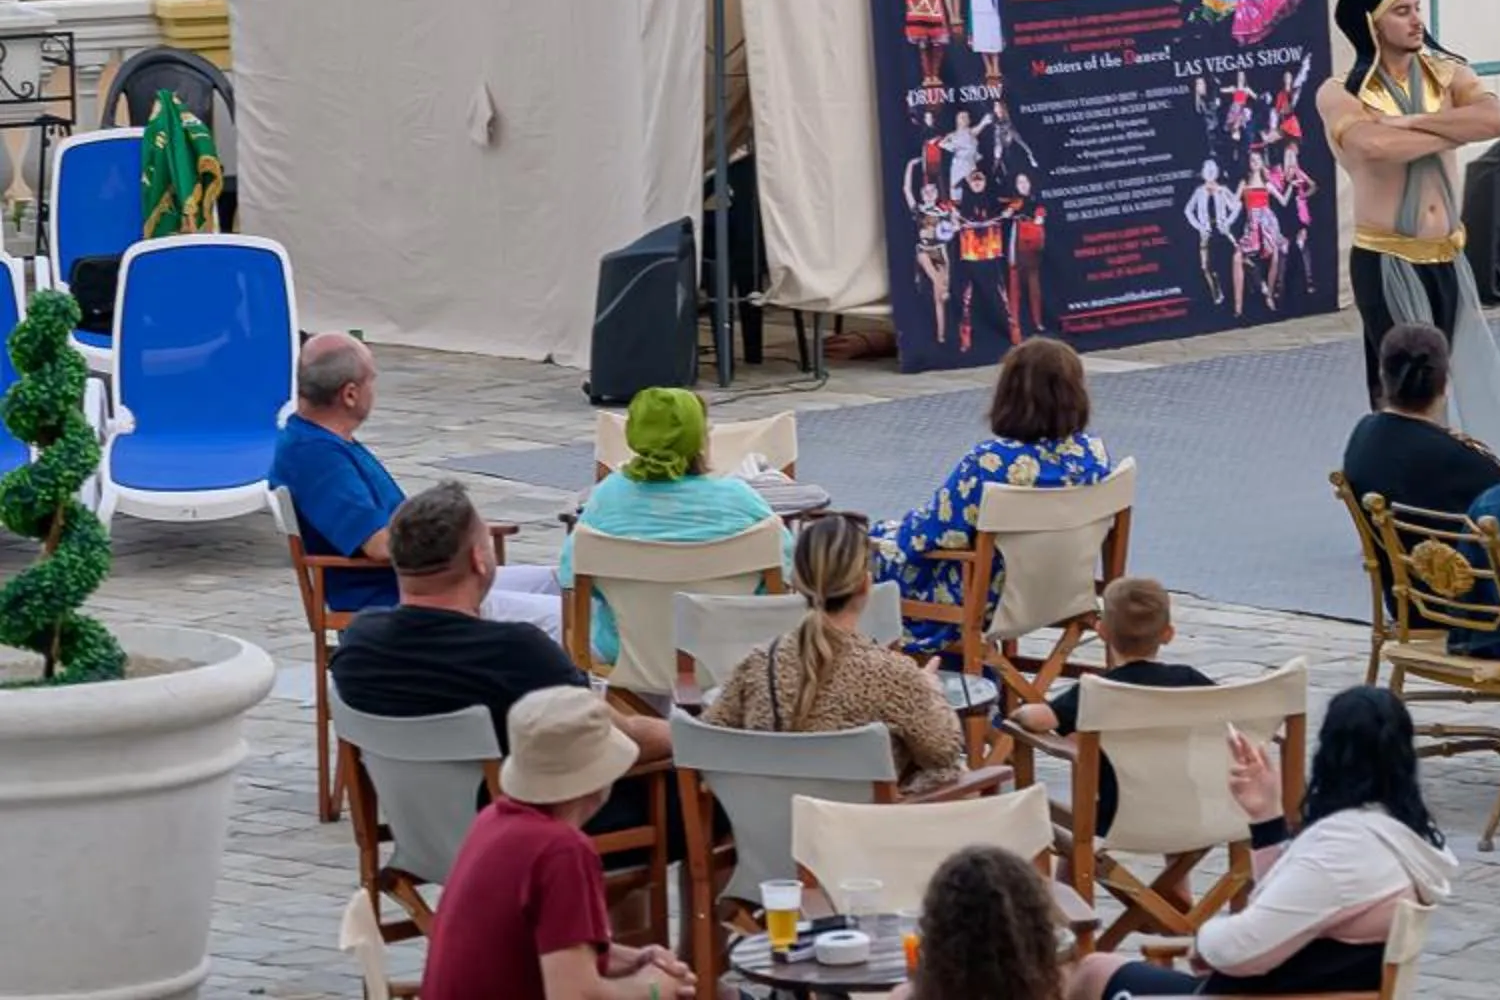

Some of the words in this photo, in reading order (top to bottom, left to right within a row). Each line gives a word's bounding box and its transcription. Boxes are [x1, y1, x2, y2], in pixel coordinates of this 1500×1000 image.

[1084, 53, 1097, 71] of
[1099, 51, 1122, 69] the
[1174, 60, 1202, 77] LAS
[1204, 53, 1254, 73] VEGAS
[1256, 47, 1302, 67] SHOW
[907, 87, 955, 107] DRUM
[960, 84, 1003, 103] SHOW
